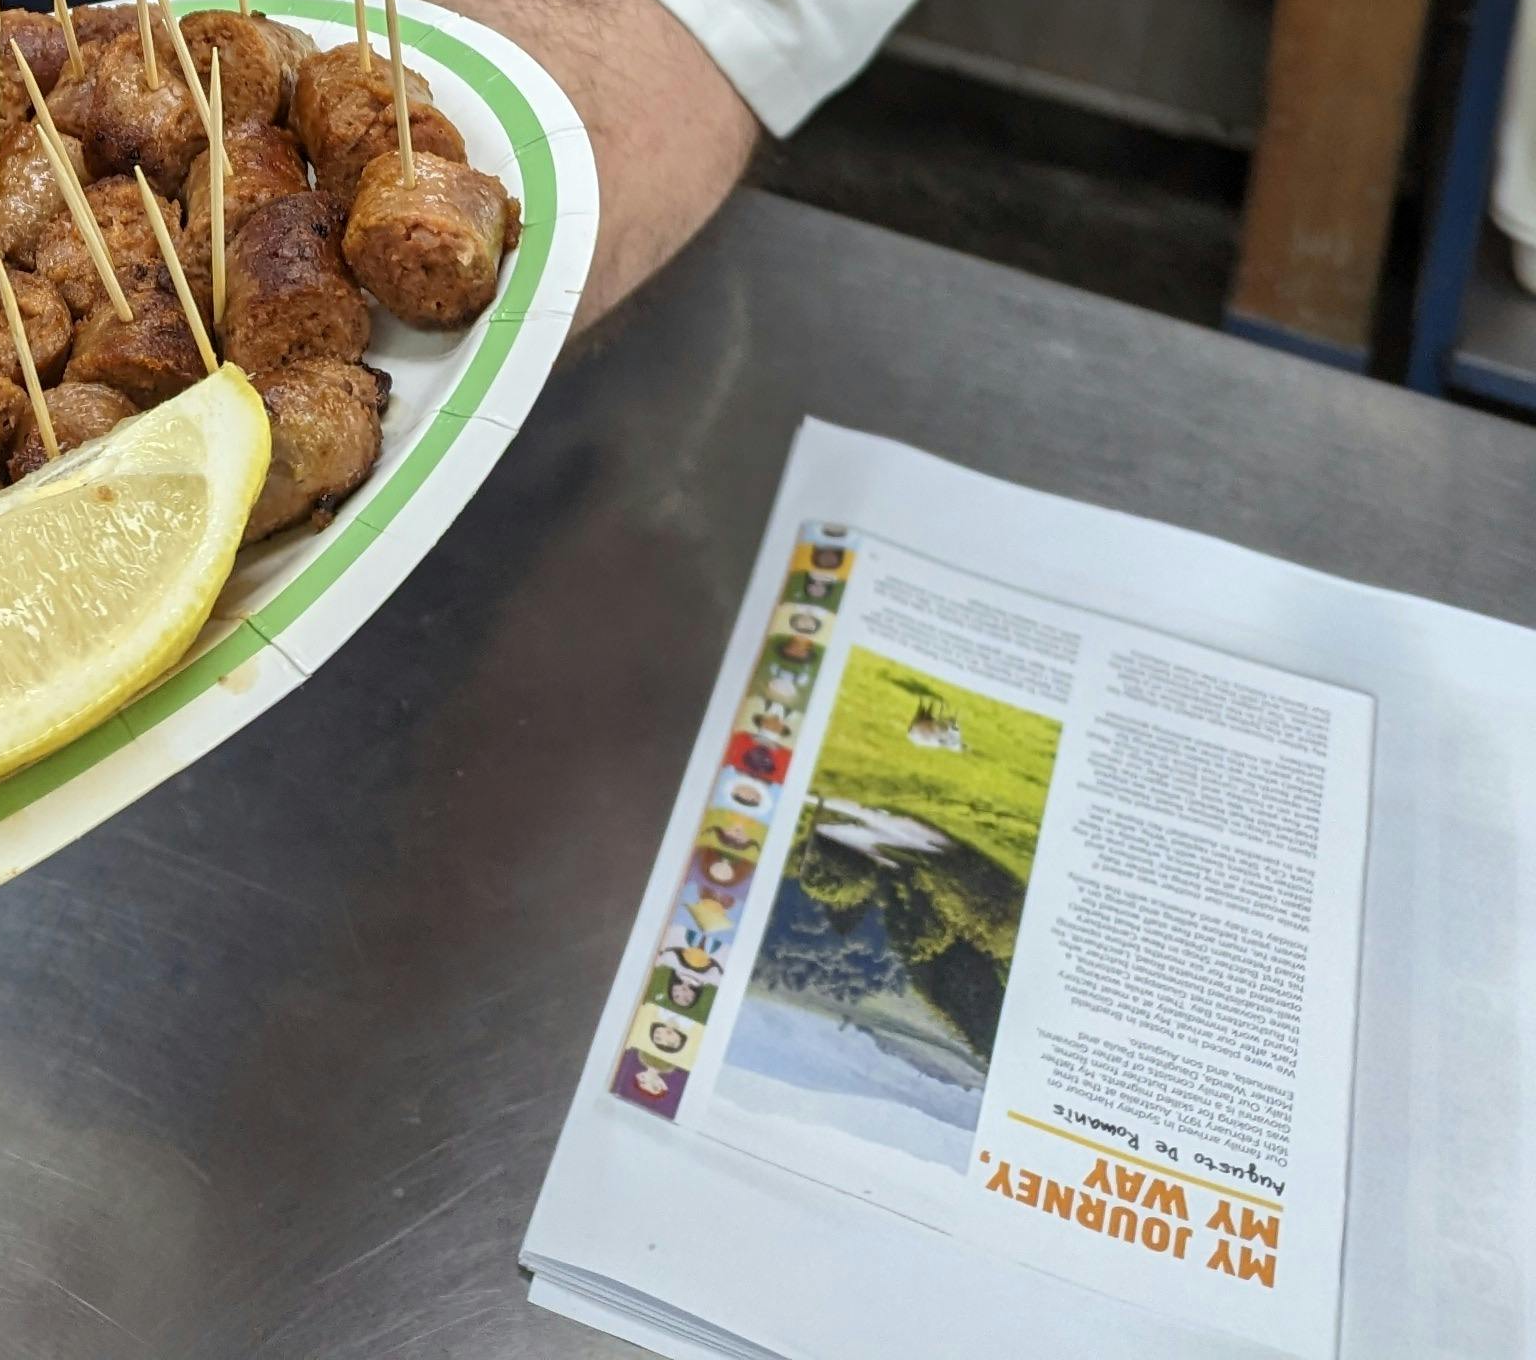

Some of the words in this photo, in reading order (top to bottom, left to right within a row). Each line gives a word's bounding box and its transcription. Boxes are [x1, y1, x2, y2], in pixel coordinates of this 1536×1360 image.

[1056, 967, 1097, 991] factory
[1063, 982, 1114, 1007] Giovanni
[1100, 984, 1129, 1000] meat
[1069, 995, 1123, 1021] Bradfield
[1116, 1000, 1151, 1020] father
[1153, 1010, 1171, 1026] My
[1156, 1001, 1228, 1034] immediately
[1076, 1030, 1100, 1045] and
[1138, 1018, 1175, 1039] hostel
[1231, 1027, 1260, 1043] work
[1091, 1047, 1129, 1068] Father
[1102, 1039, 1135, 1058] Paula
[1200, 1039, 1241, 1059] placed
[1239, 1040, 1267, 1056] after
[1262, 1037, 1298, 1057] found
[1040, 1050, 1075, 1071] father
[1090, 1058, 1119, 1076] from
[1137, 1051, 1199, 1080] Daughters
[1181, 1054, 1204, 1069] son
[1243, 1053, 1273, 1069] were
[1270, 1050, 1297, 1067] Park
[1051, 1066, 1080, 1084] time
[1077, 1062, 1096, 1079] My
[1147, 1066, 1195, 1089] consists
[1205, 1063, 1229, 1077] and
[1275, 1063, 1296, 1078] We
[1081, 1077, 1102, 1093] the
[1122, 1069, 1168, 1093] butcher
[1065, 1083, 1114, 1109] Harbour
[1155, 1091, 1194, 1111] skilled
[1170, 1086, 1212, 1106] master
[1198, 1081, 1234, 1104] family
[1250, 1089, 1293, 1112] Mother
[1116, 1099, 1161, 1125] Sydney
[1118, 1090, 1171, 1117] Australia
[1197, 1106, 1214, 1120] for
[1237, 1096, 1260, 1112] Our
[1053, 1103, 1140, 1151] Romanis
[1217, 1110, 1263, 1137] looking
[1237, 1108, 1291, 1135] Giovanni
[1176, 1122, 1220, 1144] arrived
[1205, 1118, 1260, 1148] February
[1266, 1129, 1290, 1144] was
[1155, 1140, 1179, 1162] De
[1223, 1136, 1261, 1160] family
[1262, 1140, 1289, 1157] 16th
[1265, 1152, 1288, 1169] Our
[1194, 1152, 1286, 1196] Augusto
[1083, 1158, 1190, 1221] WAY
[979, 1150, 1194, 1260] JOURNEY,
[1206, 1199, 1280, 1250] MY
[1206, 1239, 1277, 1289] MY
